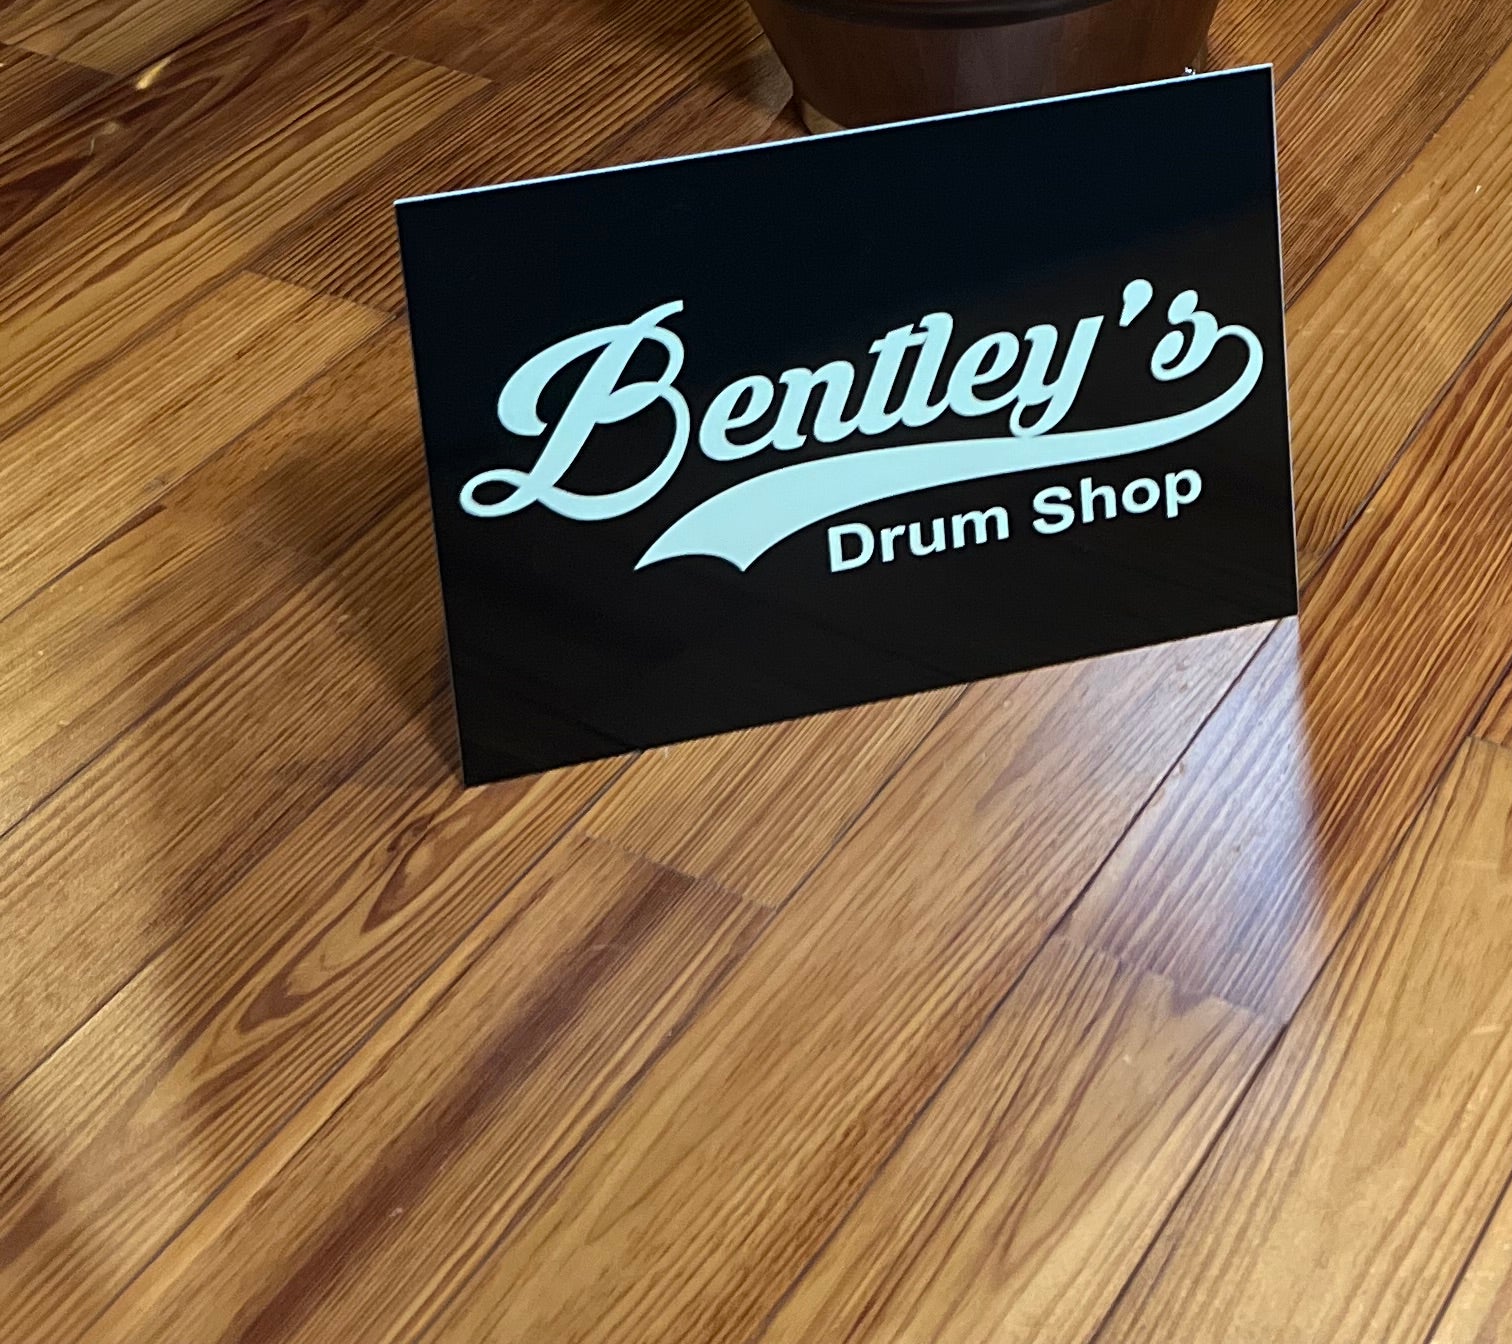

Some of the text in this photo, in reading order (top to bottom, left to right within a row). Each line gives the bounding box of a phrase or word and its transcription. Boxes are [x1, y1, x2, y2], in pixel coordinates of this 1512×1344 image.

[460, 278, 1240, 521] Bentley's
[827, 469, 1202, 573] Drum Shop
